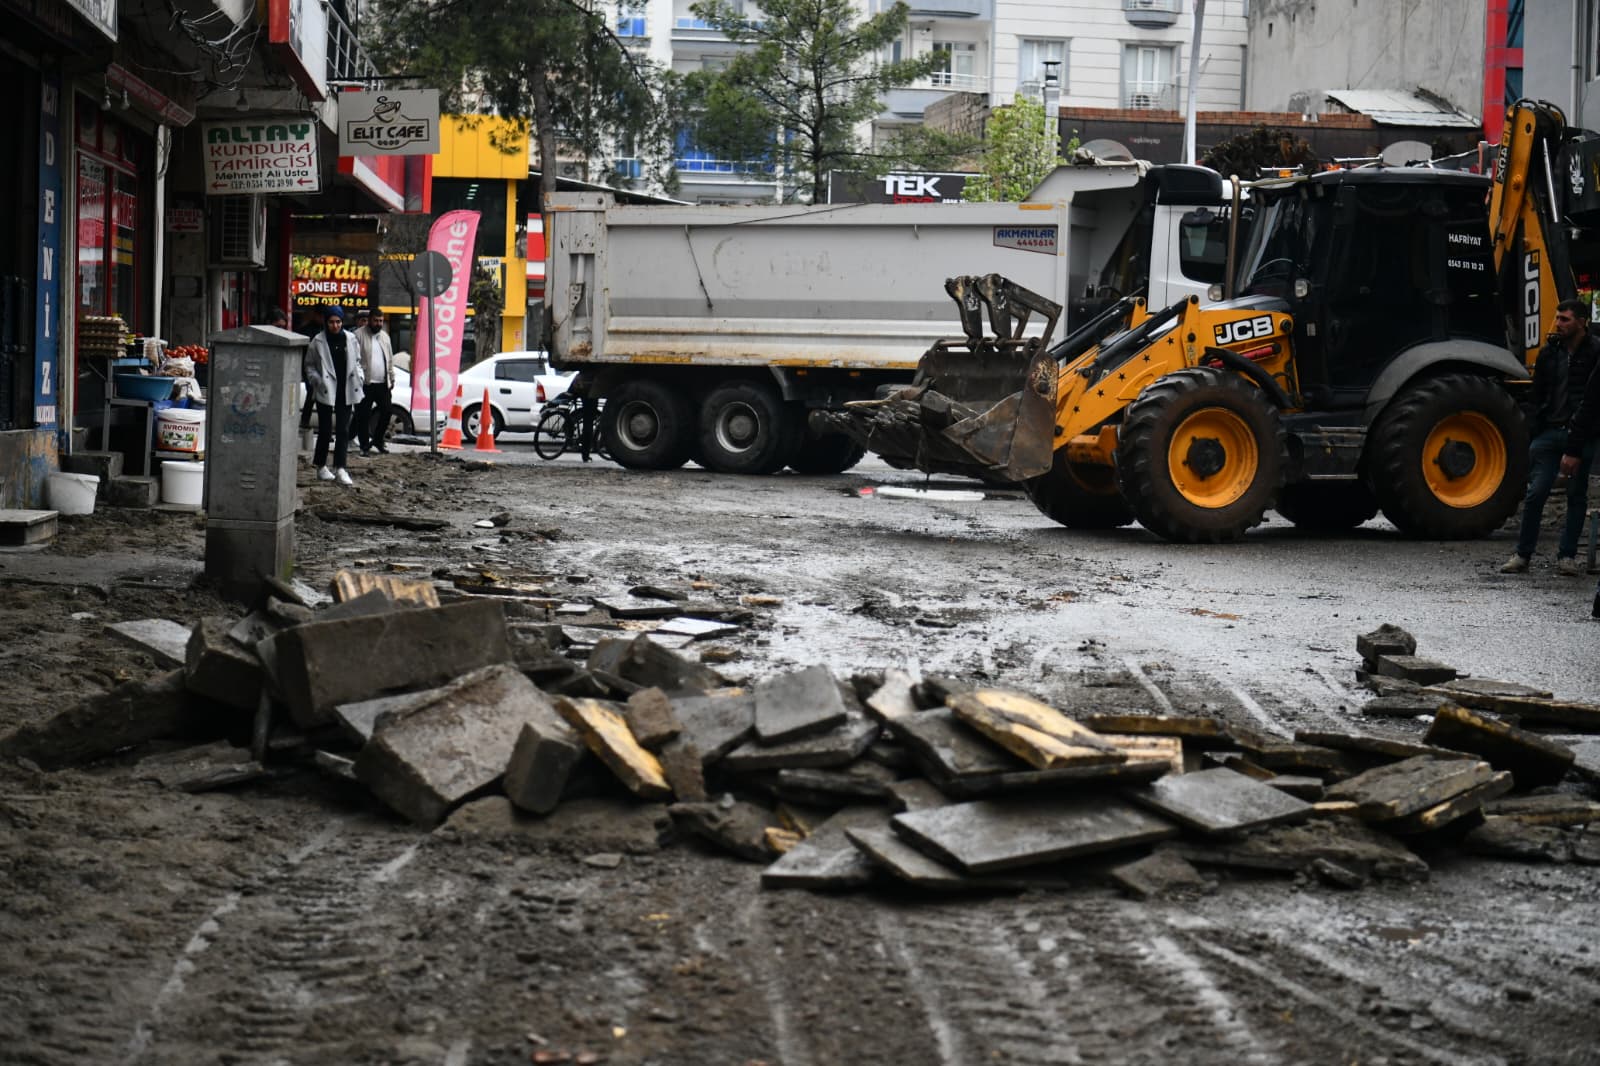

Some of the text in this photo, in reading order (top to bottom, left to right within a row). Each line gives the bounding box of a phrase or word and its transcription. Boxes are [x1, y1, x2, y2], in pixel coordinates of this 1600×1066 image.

[207, 124, 310, 143] ALTAY
[387, 125, 425, 138] CAFE
[210, 143, 310, 156] KUNDURA
[209, 154, 313, 170] TAMİRCİSİ
[215, 169, 309, 180] Mehmet Ali Usta
[876, 174, 942, 196] TEK
[997, 229, 1056, 239] AKMANLAR
[1448, 233, 1482, 246] HAFRİYAT
[292, 256, 371, 281] Mardin
[298, 279, 359, 295] DÖNER EVİ
[297, 297, 320, 306] 0531
[342, 298, 355, 307] 42
[356, 298, 369, 307] 84
[1524, 252, 1540, 349] JCB
[1216, 316, 1273, 345] JCB
